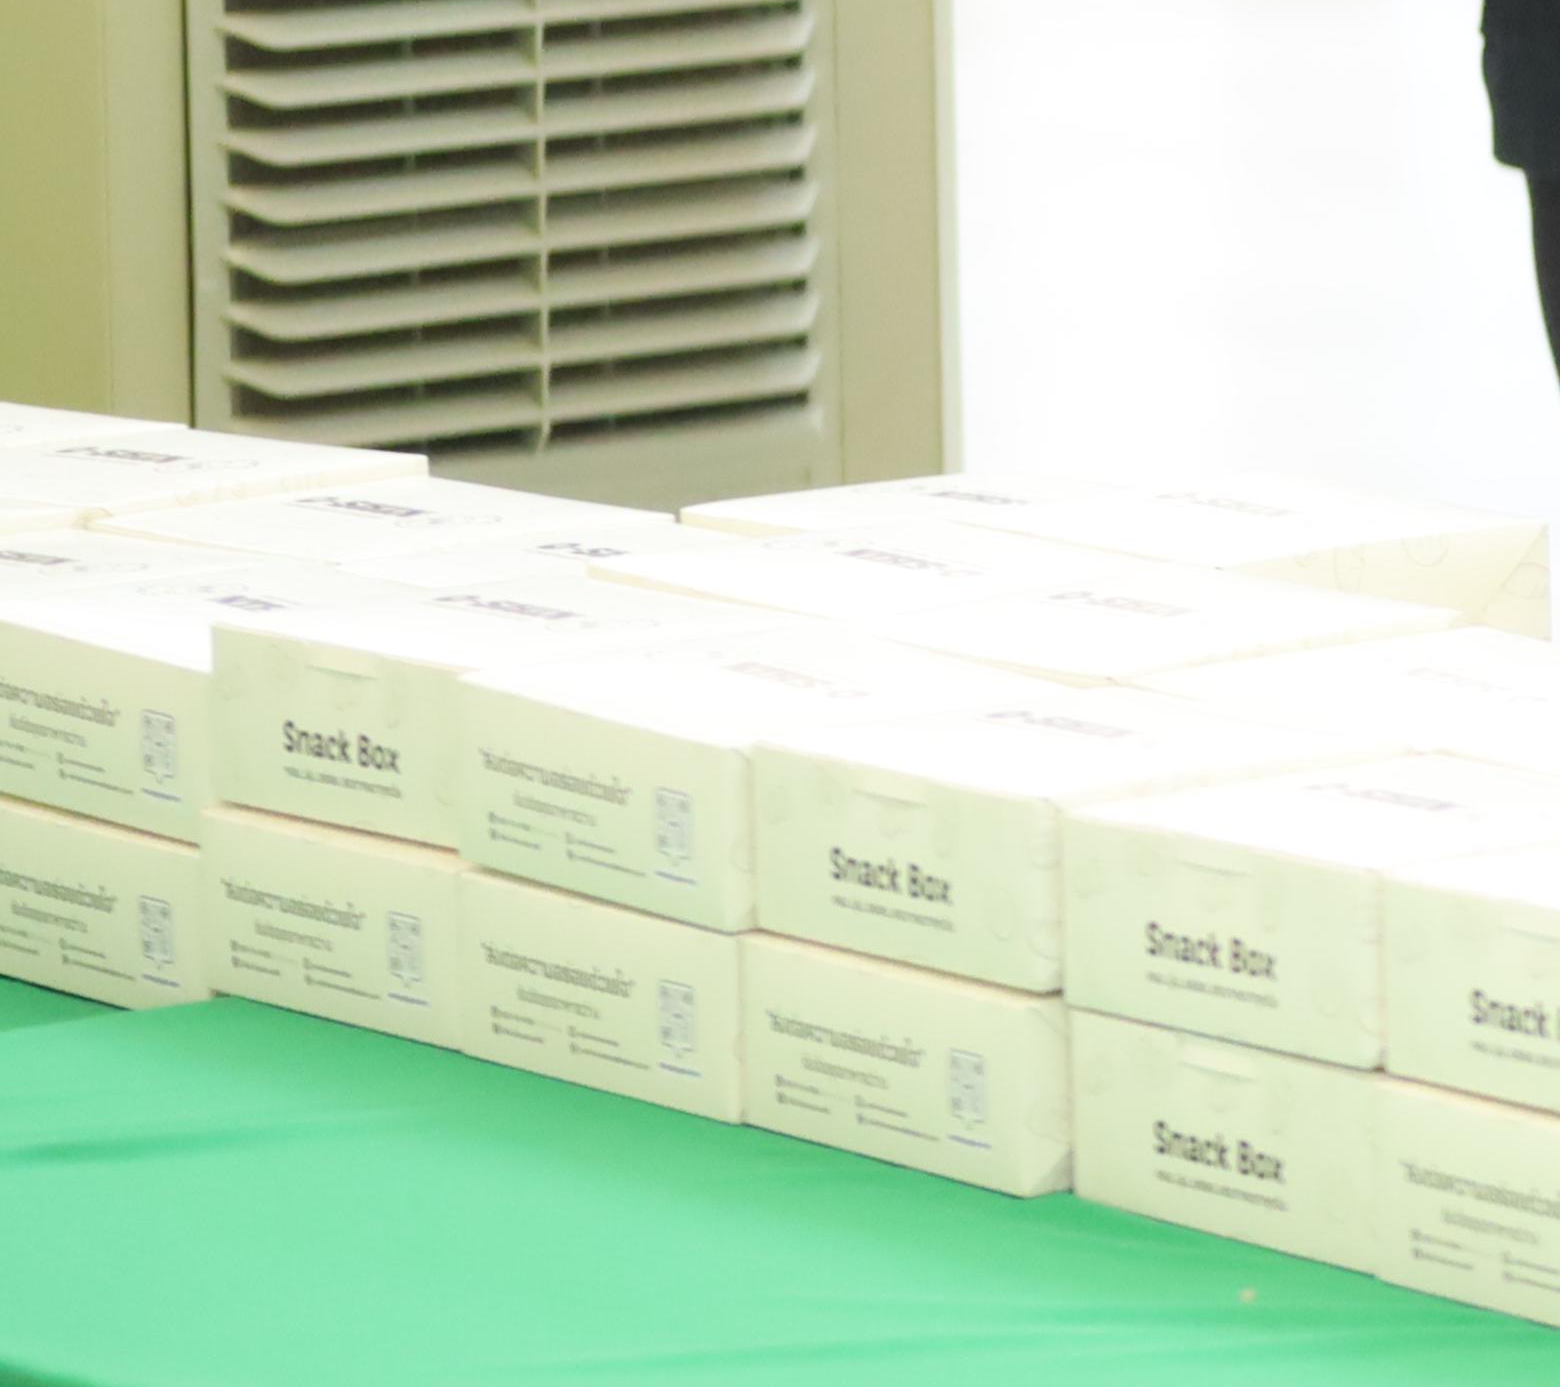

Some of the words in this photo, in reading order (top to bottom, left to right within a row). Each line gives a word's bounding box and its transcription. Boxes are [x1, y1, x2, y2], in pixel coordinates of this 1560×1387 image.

[283, 720, 351, 763] Snack
[358, 735, 400, 774] Box
[831, 847, 900, 894] Snack
[909, 864, 952, 906] Box
[1146, 921, 1221, 968] Snack
[1231, 938, 1277, 979] Box
[1471, 990, 1549, 1037] Snack
[1153, 1121, 1229, 1169] Snack
[1238, 1140, 1285, 1184] Box
